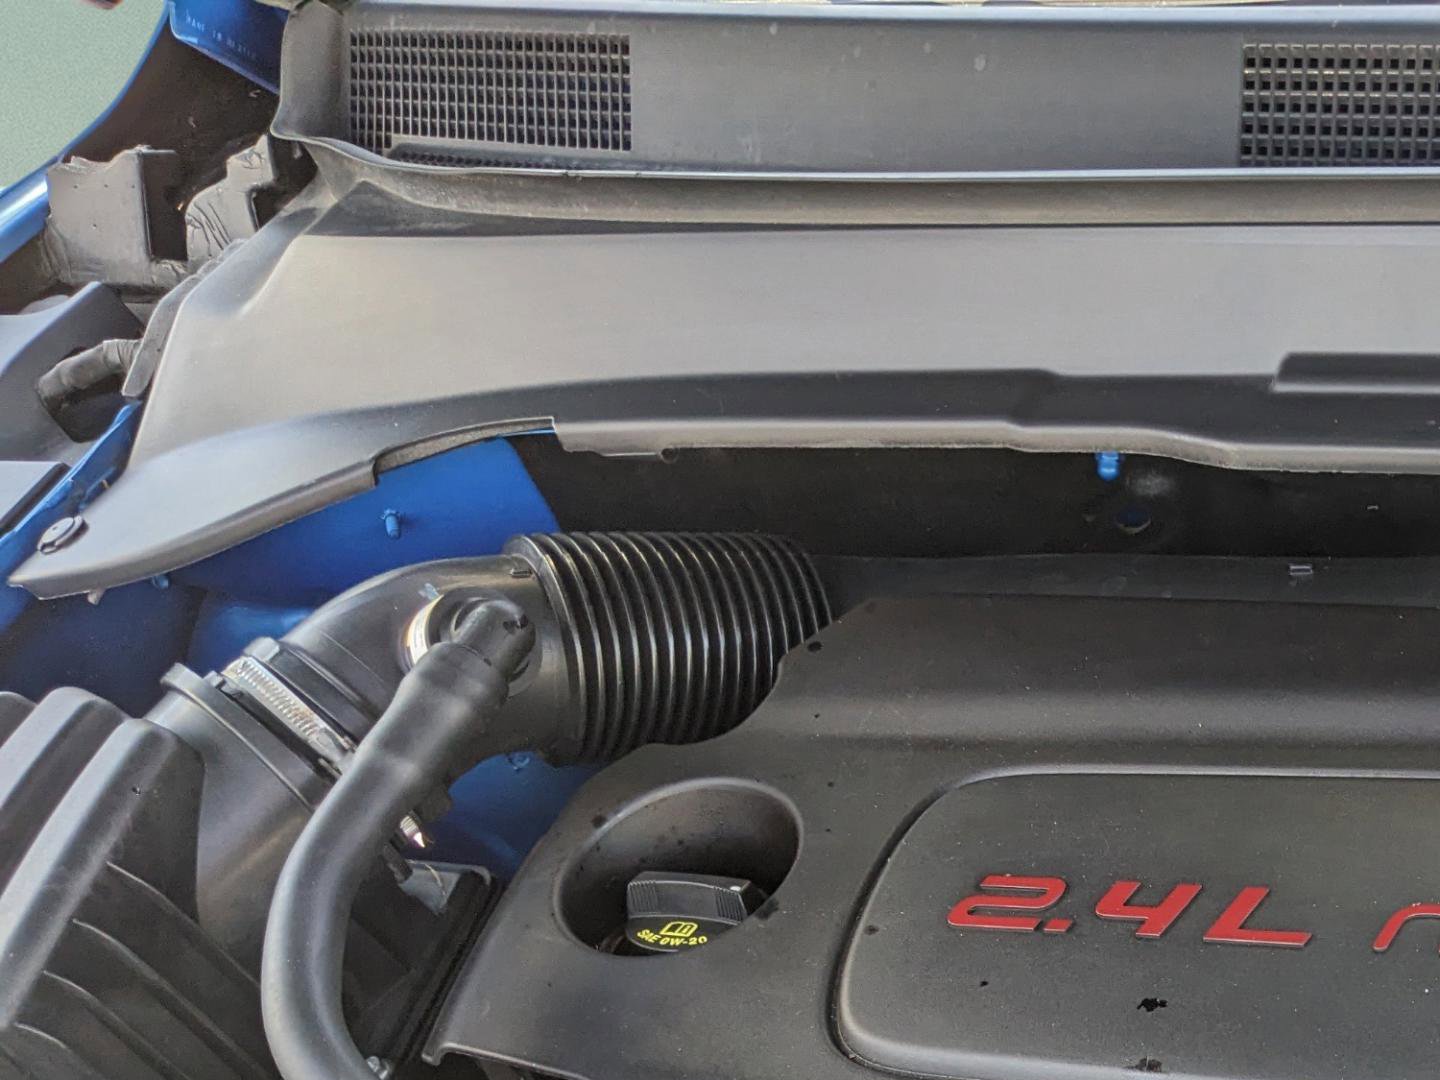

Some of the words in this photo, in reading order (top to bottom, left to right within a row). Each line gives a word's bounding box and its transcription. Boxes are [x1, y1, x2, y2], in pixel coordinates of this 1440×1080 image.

[949, 874, 1306, 942] 2.4L
[636, 929, 661, 944] SAE
[659, 935, 708, 946] 0W-20
